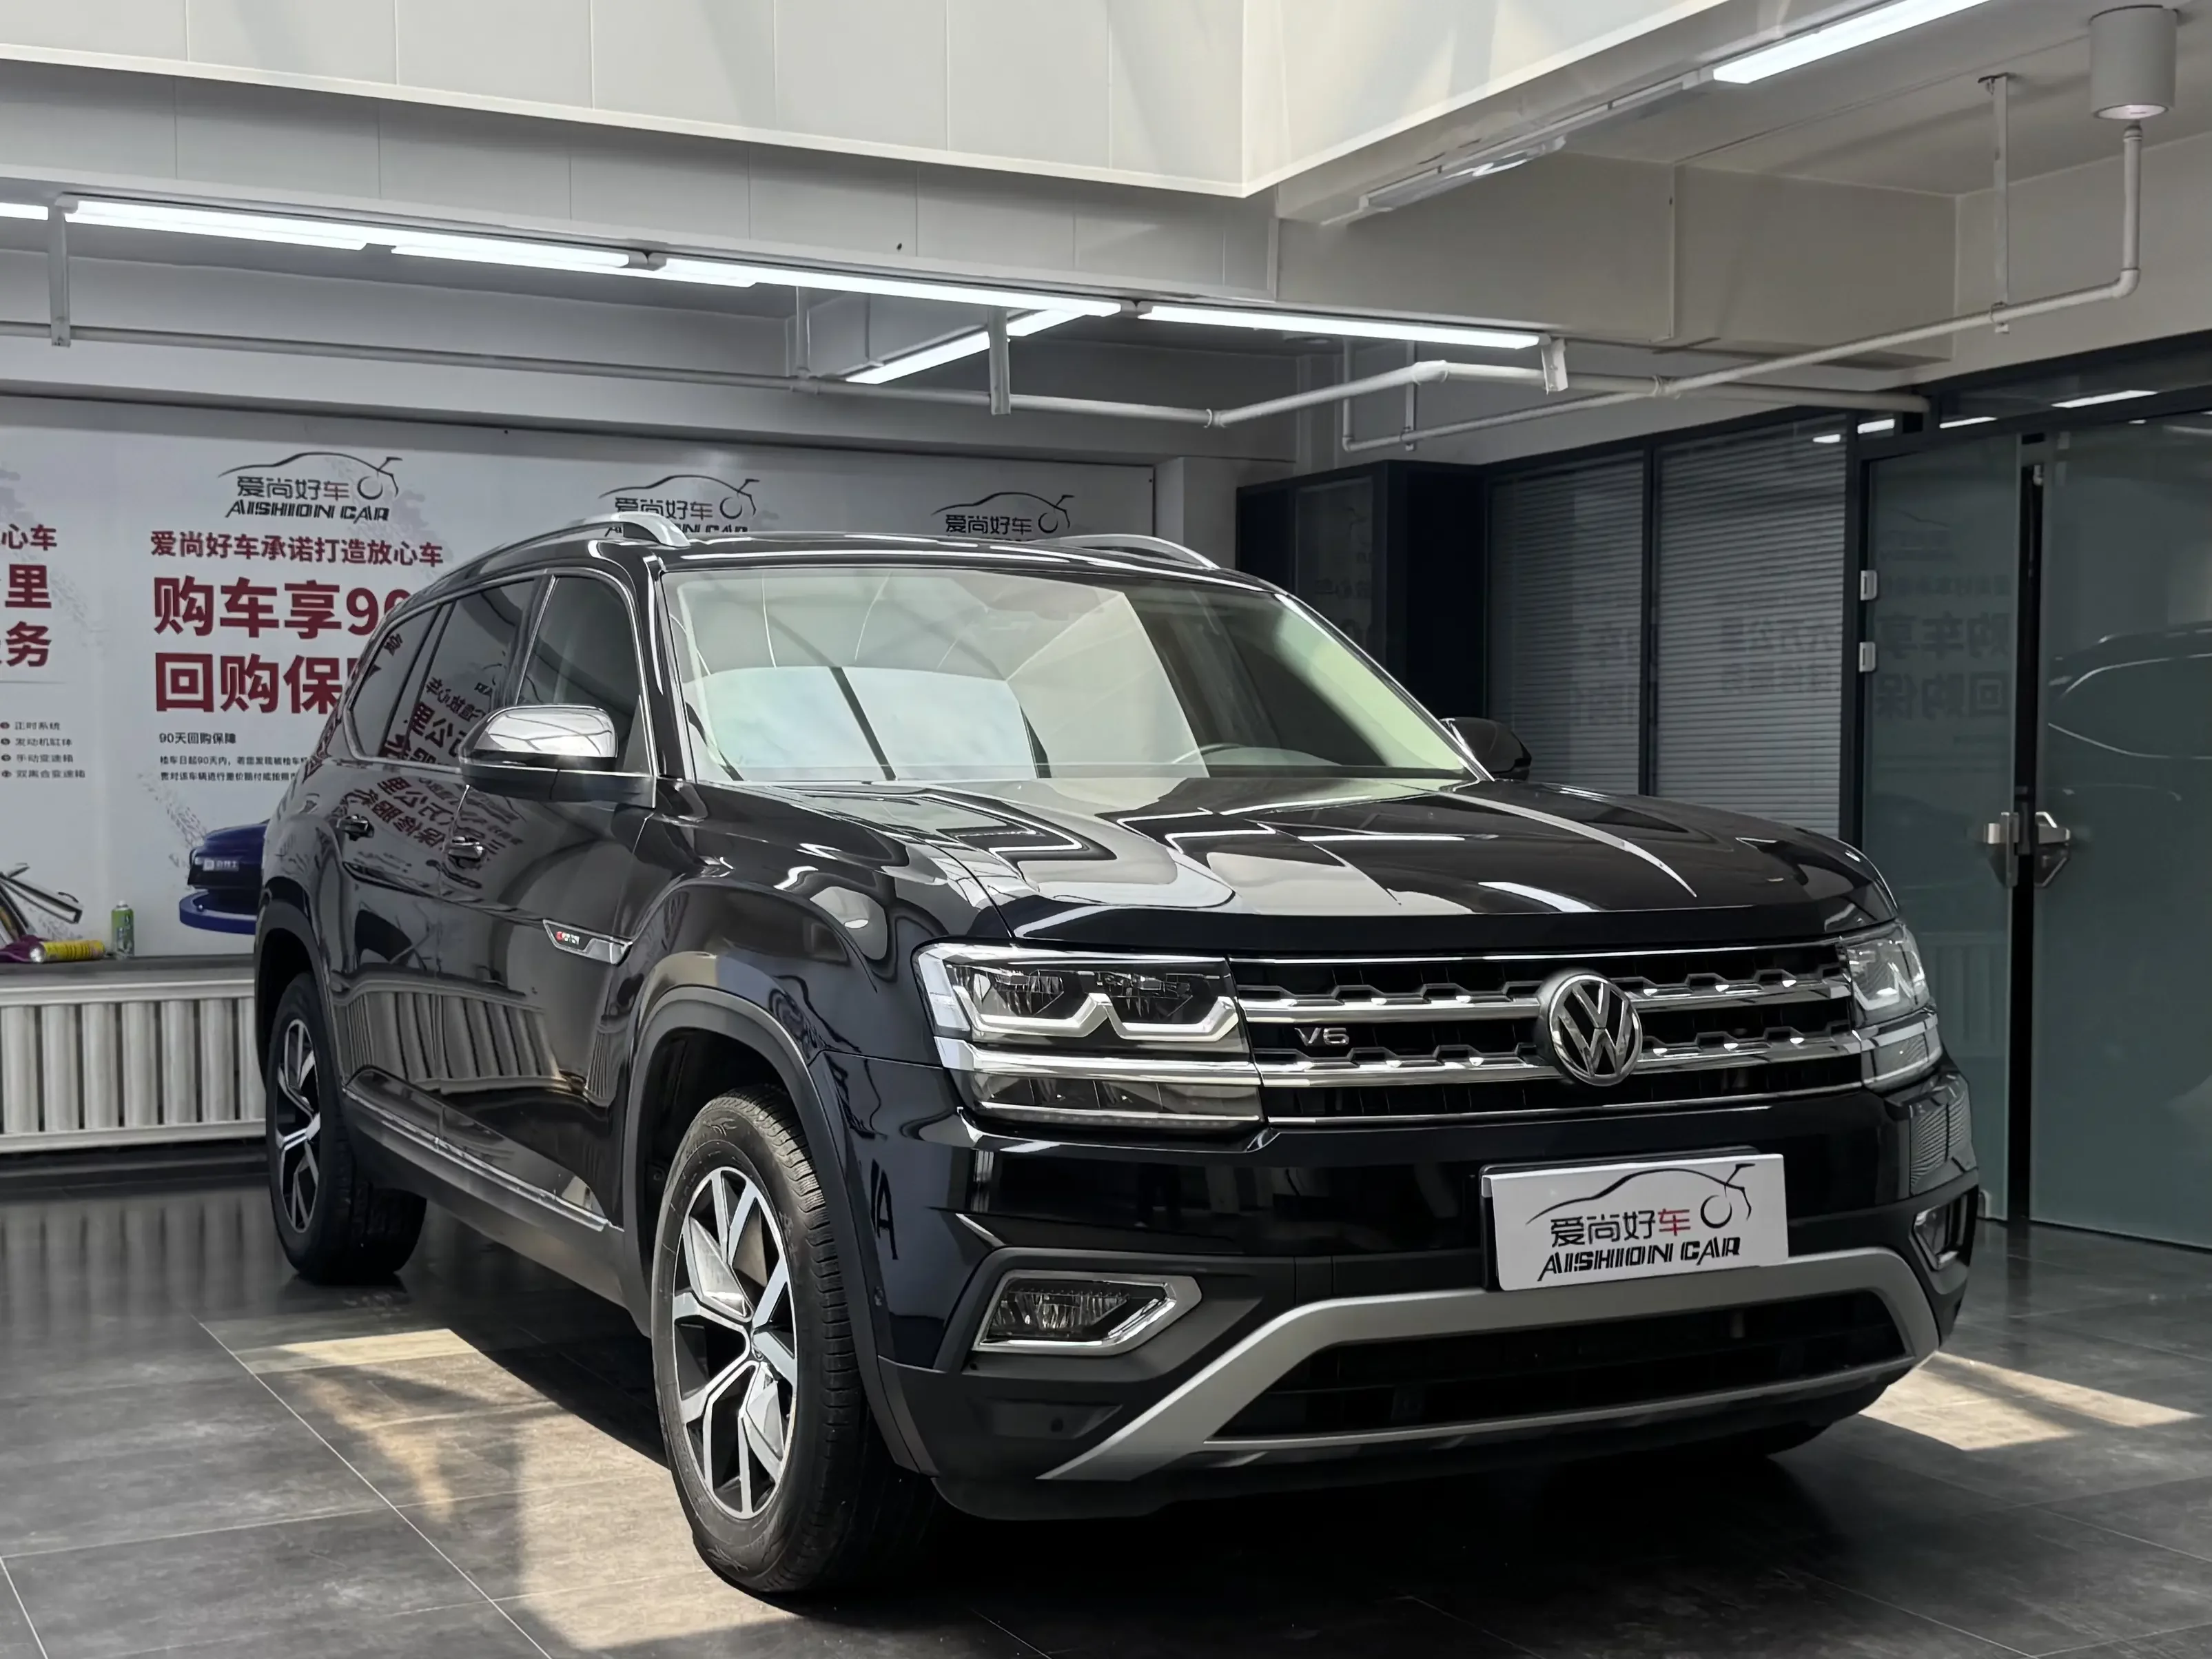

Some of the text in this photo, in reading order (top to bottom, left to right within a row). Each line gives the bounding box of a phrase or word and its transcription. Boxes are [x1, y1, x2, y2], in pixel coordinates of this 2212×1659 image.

[237, 475, 349, 502] 爱尚好车
[340, 504, 390, 524] CAR
[945, 514, 1032, 535] 爱尚好车
[150, 530, 444, 567] 爱尚好车承诺打造放心车
[156, 652, 360, 714] 回购保
[158, 732, 236, 745] 90天回购保障
[1294, 1027, 1350, 1047] V6
[1550, 1208, 1691, 1248] 爱尚好车
[1680, 1237, 1741, 1266] CAR
